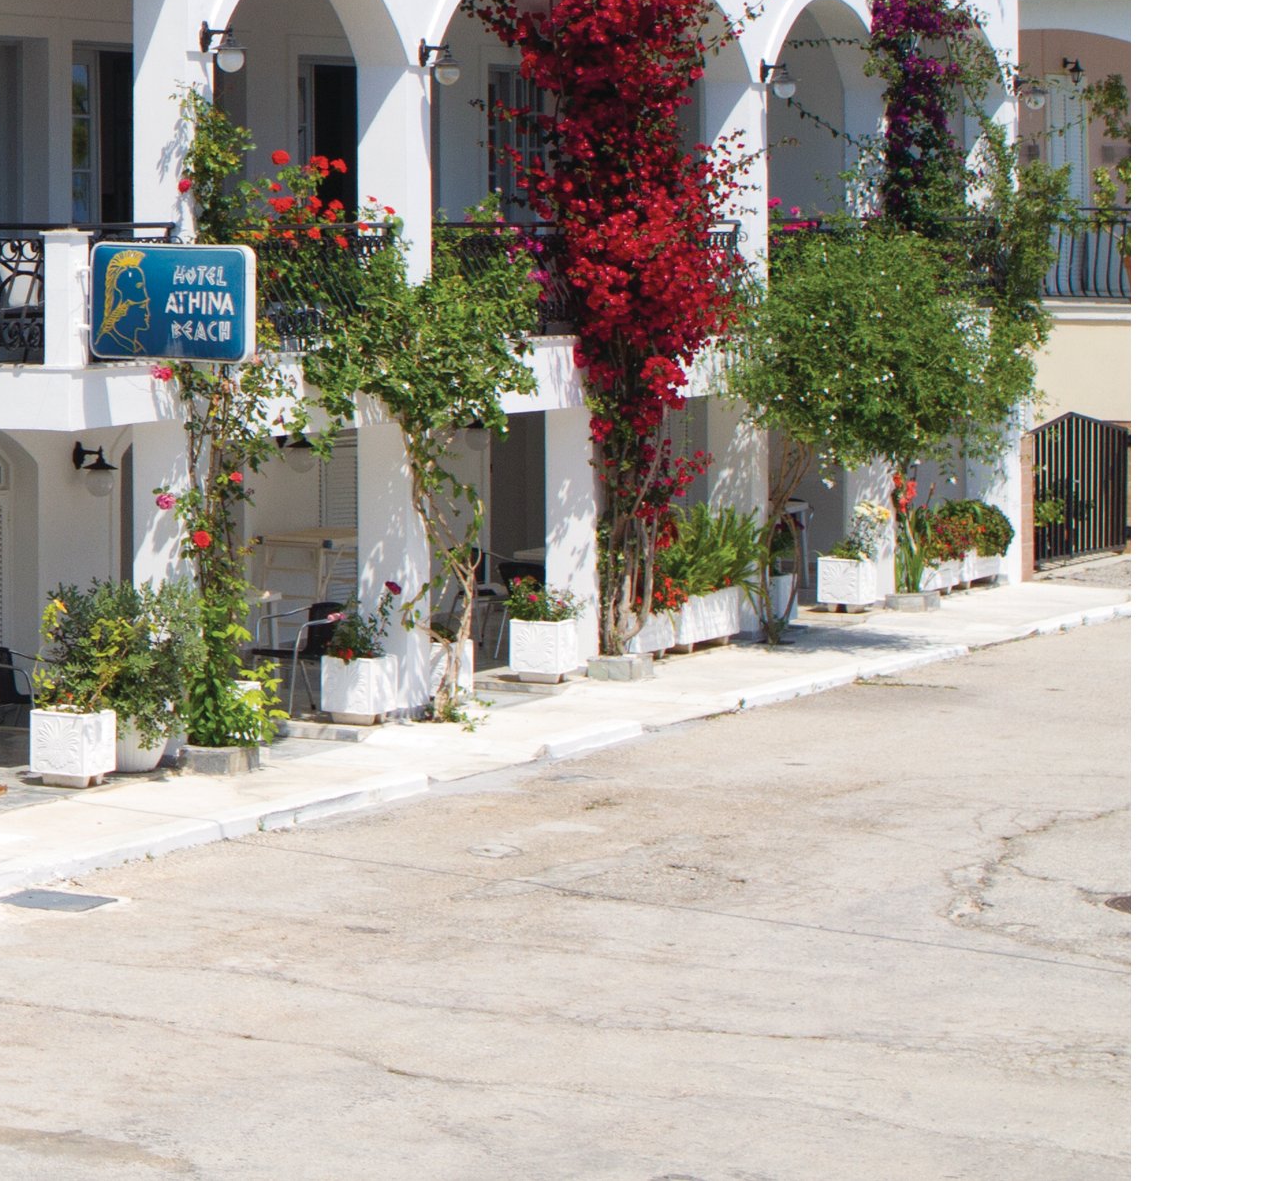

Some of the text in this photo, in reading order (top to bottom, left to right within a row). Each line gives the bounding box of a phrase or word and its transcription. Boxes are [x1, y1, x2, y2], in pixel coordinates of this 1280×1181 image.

[173, 265, 227, 286] HOTEL
[165, 291, 235, 315] ATHINA
[171, 320, 231, 342] BEACH
